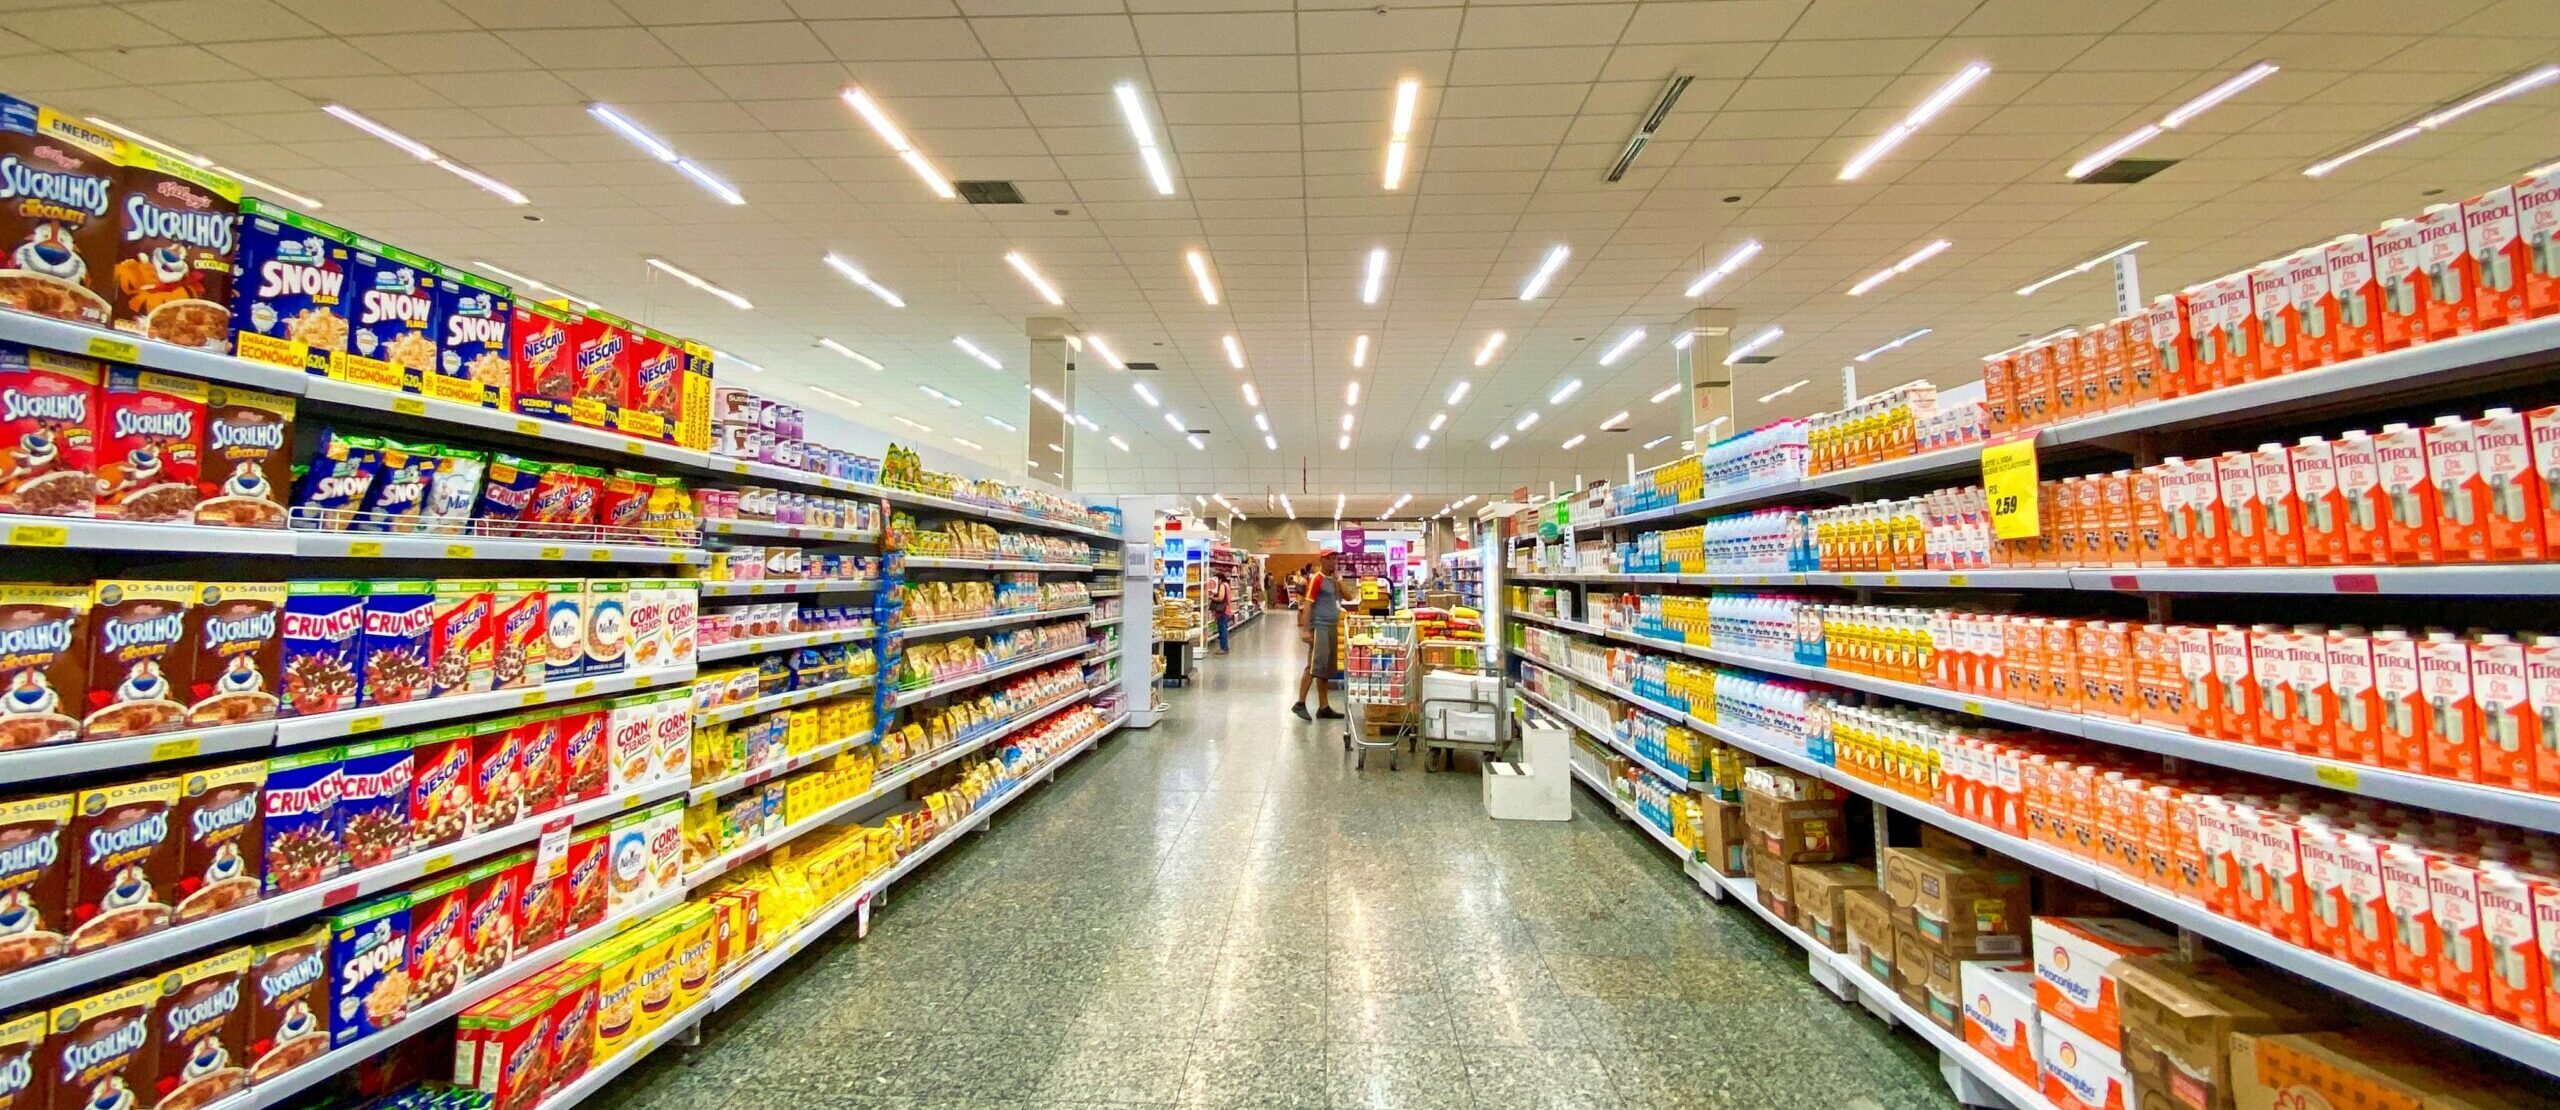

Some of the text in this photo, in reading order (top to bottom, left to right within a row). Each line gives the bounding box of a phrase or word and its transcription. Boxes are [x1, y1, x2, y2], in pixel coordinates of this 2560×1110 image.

[53, 118, 115, 150] ENERGIA
[1, 156, 111, 217] SUCRILHOS
[127, 196, 234, 255] SUCRILHOS
[2467, 205, 2513, 229] TIROL
[2534, 209, 2552, 224] 0%
[2418, 221, 2462, 244] TIROL
[2373, 236, 2418, 257] TIROL
[2329, 250, 2369, 272] TIROL
[259, 260, 344, 298] SNOW
[2254, 275, 2288, 294] TIROL
[2290, 264, 2326, 284] TIROL
[362, 290, 432, 325] SNOW
[2190, 300, 2216, 316] TIROL
[2217, 289, 2249, 306] TIROL
[448, 314, 505, 346] SNOW
[2150, 311, 2175, 325] TIROL
[242, 335, 290, 350] EMBALAGEM
[523, 329, 565, 361] NESCAU
[577, 336, 623, 371] NESCAU
[240, 345, 304, 369] ECONÔMICA
[349, 367, 402, 388] ECONÔMICA
[638, 353, 678, 387] NESCAU
[3, 388, 86, 424] SUCRILHOS
[115, 406, 192, 439] SUCRILHOS
[212, 418, 285, 449] SUCRILHOS
[2533, 424, 2560, 443] TIR
[2427, 438, 2473, 456] TIROL
[2476, 430, 2524, 450] TIROL
[2294, 457, 2332, 473] TIROL
[2335, 451, 2375, 468] TIROL
[2376, 445, 2421, 463] TIROL
[2161, 475, 2187, 487] TIROL
[2186, 471, 2214, 484] TIROL
[2219, 467, 2251, 481] TIROL
[2255, 462, 2288, 477] TIROL
[311, 474, 373, 500] SNOW
[485, 483, 535, 509] CRUNC
[533, 483, 570, 513] NESCAU
[612, 492, 648, 520] NESCAU
[144, 584, 195, 593] SABOR
[240, 584, 286, 594] SABOR
[284, 605, 362, 638] CRUNCH
[366, 605, 434, 634] CRUNCH
[446, 603, 487, 639] NESCAU
[506, 600, 542, 637] NESCAU
[630, 603, 660, 627] CORN
[668, 603, 692, 625] CORN
[0, 618, 75, 653] UCRILHOS
[105, 612, 184, 653] SUCRILHOS
[206, 611, 276, 650] SUCRILHOS
[635, 618, 661, 636] flakes
[2180, 641, 2208, 656] TIROL
[2214, 643, 2246, 658] TIROL
[2253, 645, 2286, 660] TIROL
[2286, 647, 2323, 663] TIROL
[2328, 650, 2368, 667] TIROL
[2375, 652, 2415, 670] TIROL
[2421, 656, 2466, 674] TIROL
[2473, 658, 2523, 678] TIROL
[617, 718, 647, 747] CORN
[658, 711, 687, 739] CORN
[522, 728, 556, 768] NESCAU
[567, 720, 602, 761] NESCAU
[623, 734, 652, 756] flakes
[224, 764, 266, 778] SABOR
[417, 749, 467, 802] NESCAU
[479, 740, 520, 788] NESCAU
[129, 781, 180, 796] SABOR
[342, 757, 413, 799] CRUNCH
[266, 771, 343, 814] CRUNCH
[13, 798, 72, 813] SABOR
[193, 791, 258, 841] SUCRILHOS
[2197, 813, 2229, 833] TIROL
[2229, 823, 2260, 844] TIROL
[90, 809, 168, 865] SUCRILHOS
[652, 824, 679, 855] CORN
[2260, 832, 2291, 853] TIROL
[0, 833, 59, 876] RILHOS
[2301, 843, 2336, 865] TIROL
[2339, 853, 2377, 877] TIROL
[570, 844, 606, 893] NESCAU
[2383, 865, 2426, 888] TIROL
[2431, 877, 2474, 902] TIROL
[468, 879, 511, 939] NESCAU
[2481, 889, 2527, 916] TIROL
[414, 900, 464, 965] NESCAU
[201, 950, 250, 971] SABOR
[679, 940, 712, 965] Cheerios
[342, 936, 407, 995] SNOW
[641, 960, 676, 987] Cheerios
[262, 951, 323, 1007] SUCRILHOS
[102, 983, 157, 1004] SABOR
[600, 982, 637, 1010] Cheerios
[168, 979, 239, 1042] SUCRILHOS
[555, 985, 597, 1051] NESCAU
[63, 1013, 147, 1081] SUCRILHOS
[506, 1014, 548, 1083] NESCAU
